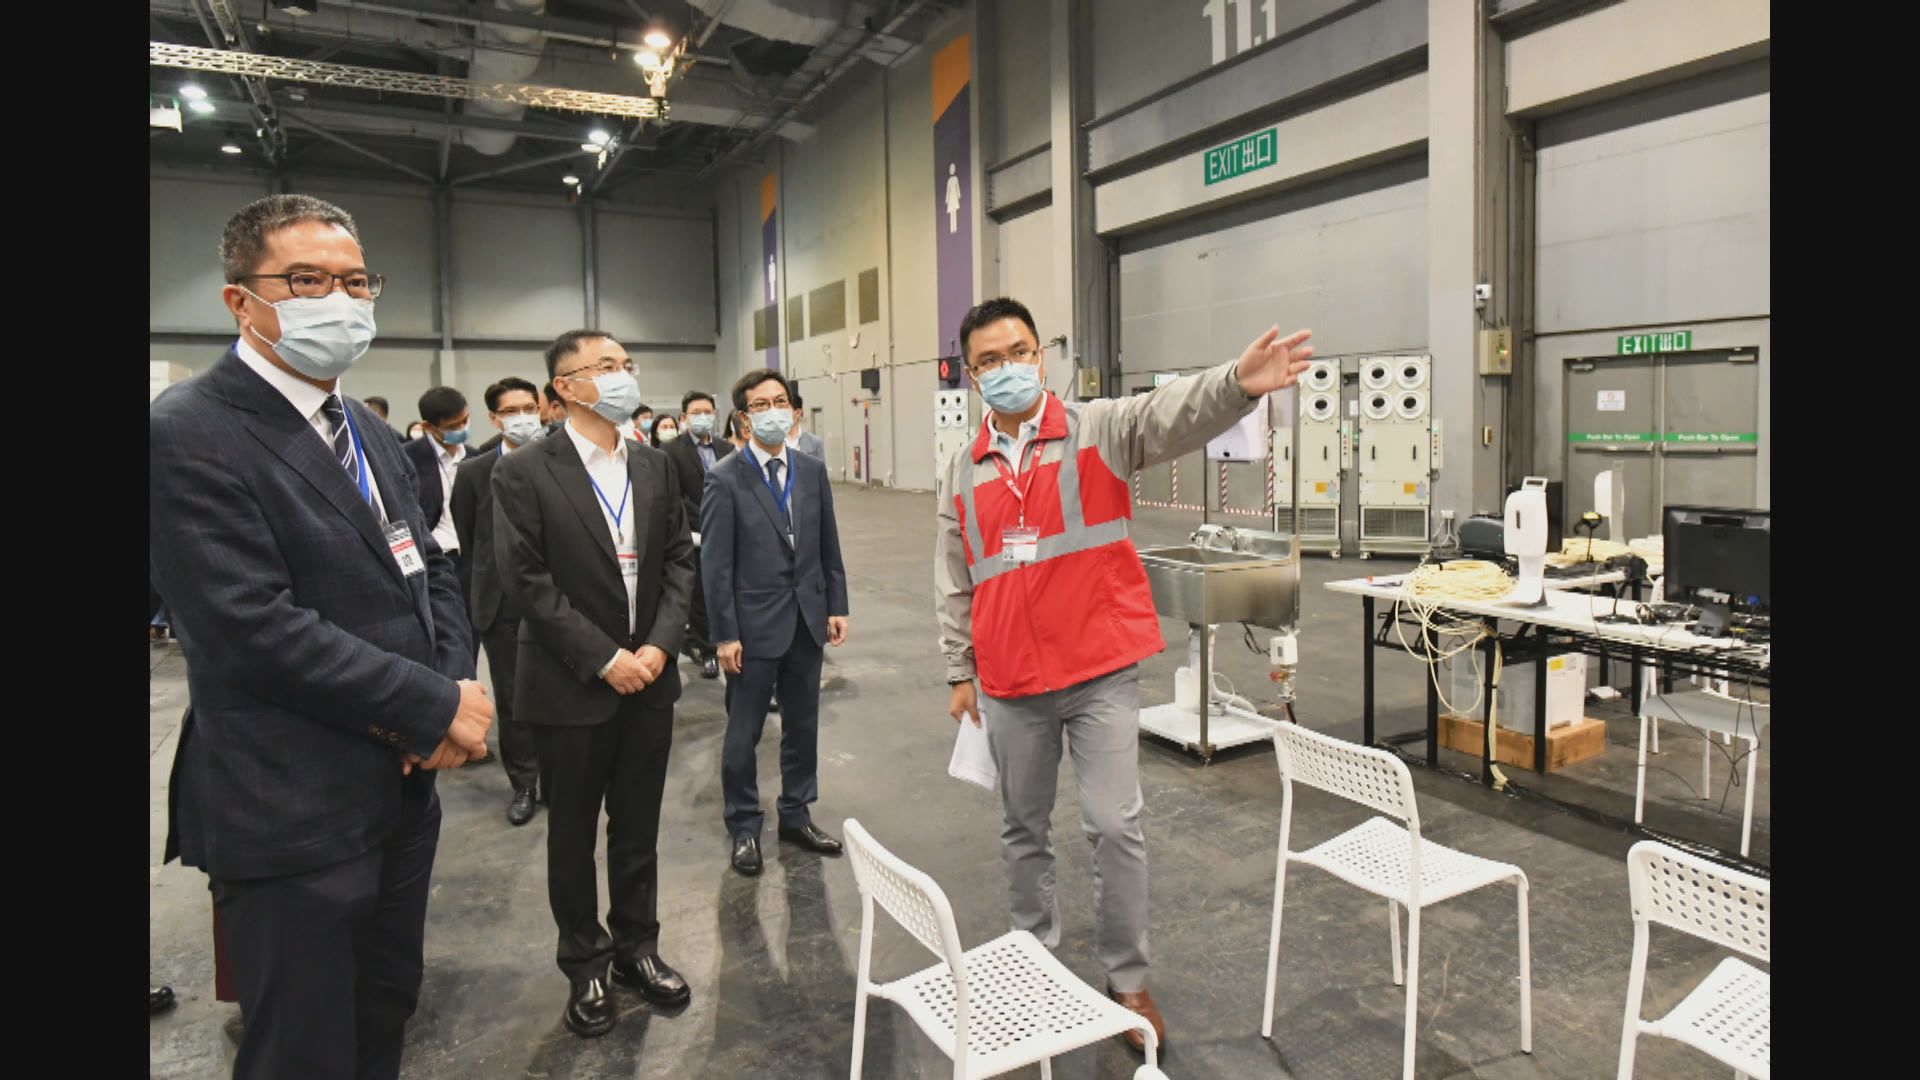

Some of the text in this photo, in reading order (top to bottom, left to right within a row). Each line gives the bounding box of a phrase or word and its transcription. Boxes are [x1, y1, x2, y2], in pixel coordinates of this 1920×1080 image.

[1203, 0, 1276, 65] 11.1
[1210, 133, 1271, 180] EXIT 出口
[1622, 332, 1686, 354] EXIT 出口
[1678, 433, 1696, 441] Push
[1696, 433, 1709, 441] Bar
[1720, 433, 1740, 441] Open
